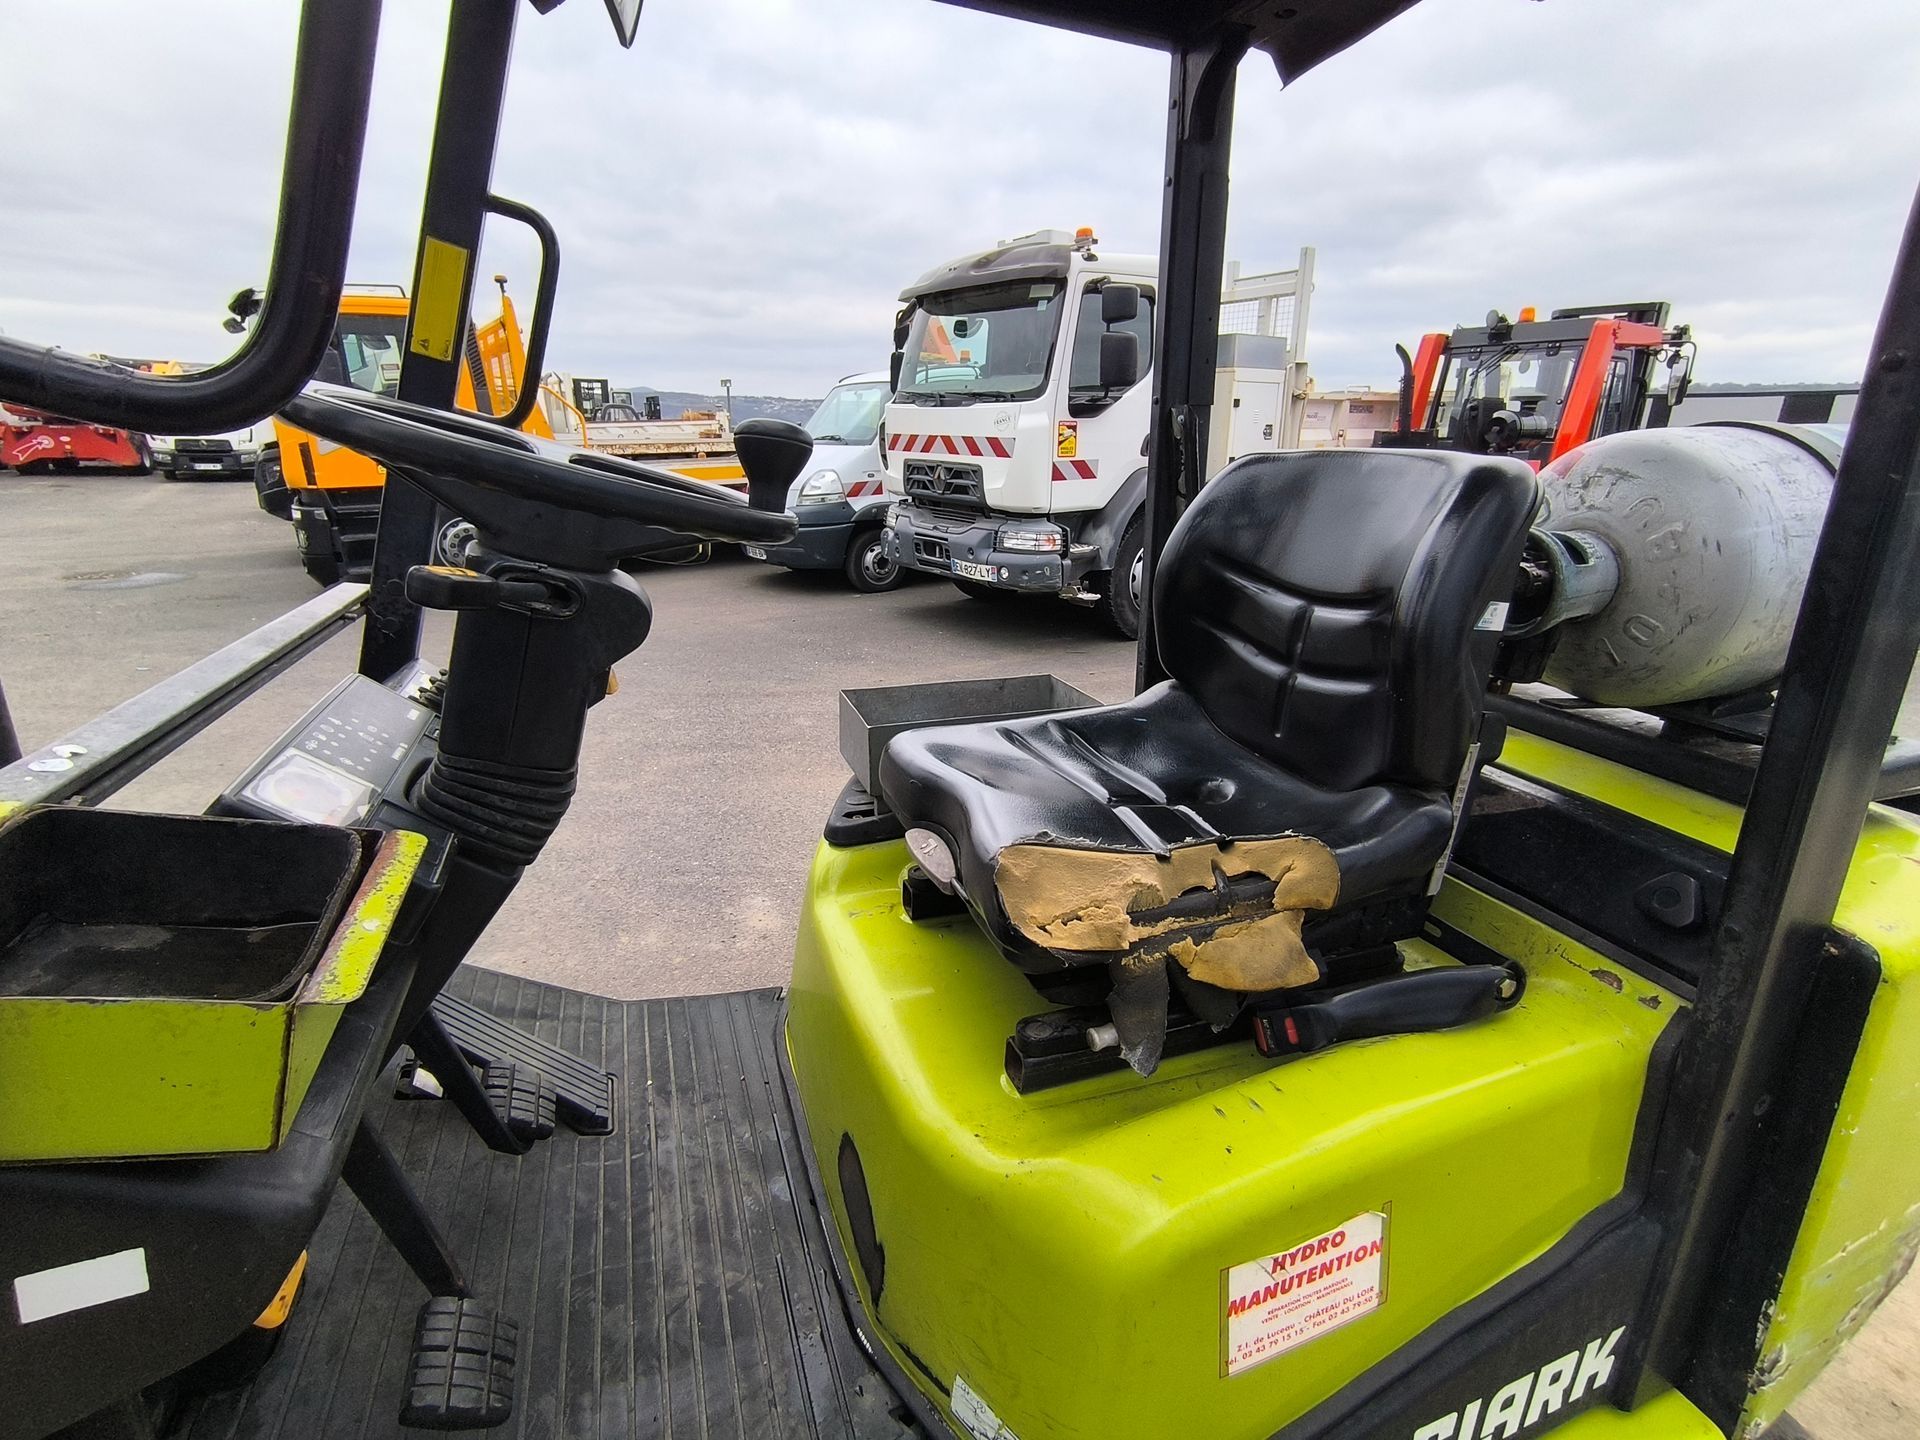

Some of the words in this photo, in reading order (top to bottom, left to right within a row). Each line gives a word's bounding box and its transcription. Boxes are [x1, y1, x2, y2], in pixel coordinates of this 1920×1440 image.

[1227, 1237, 1384, 1319] MANUTENTION
[1271, 1230, 1347, 1275] HYDRO
[1242, 1350, 1253, 1360] 02
[1255, 1344, 1266, 1353] 43
[1269, 1338, 1279, 1348] 79
[1282, 1332, 1292, 1342] 15
[1294, 1327, 1304, 1336] 15
[1312, 1318, 1326, 1329] Fax
[1328, 1311, 1338, 1321] 02
[1340, 1306, 1350, 1315] 43
[1352, 1301, 1362, 1310] 79
[1253, 1336, 1264, 1346] de
[1267, 1323, 1296, 1340] Luceau
[1304, 1301, 1341, 1323] CHÂTEAU
[1343, 1295, 1355, 1305] DU
[1357, 1285, 1375, 1299] LOIR
[1261, 1313, 1279, 1324] VENTE
[1284, 1300, 1311, 1316] LOCATION
